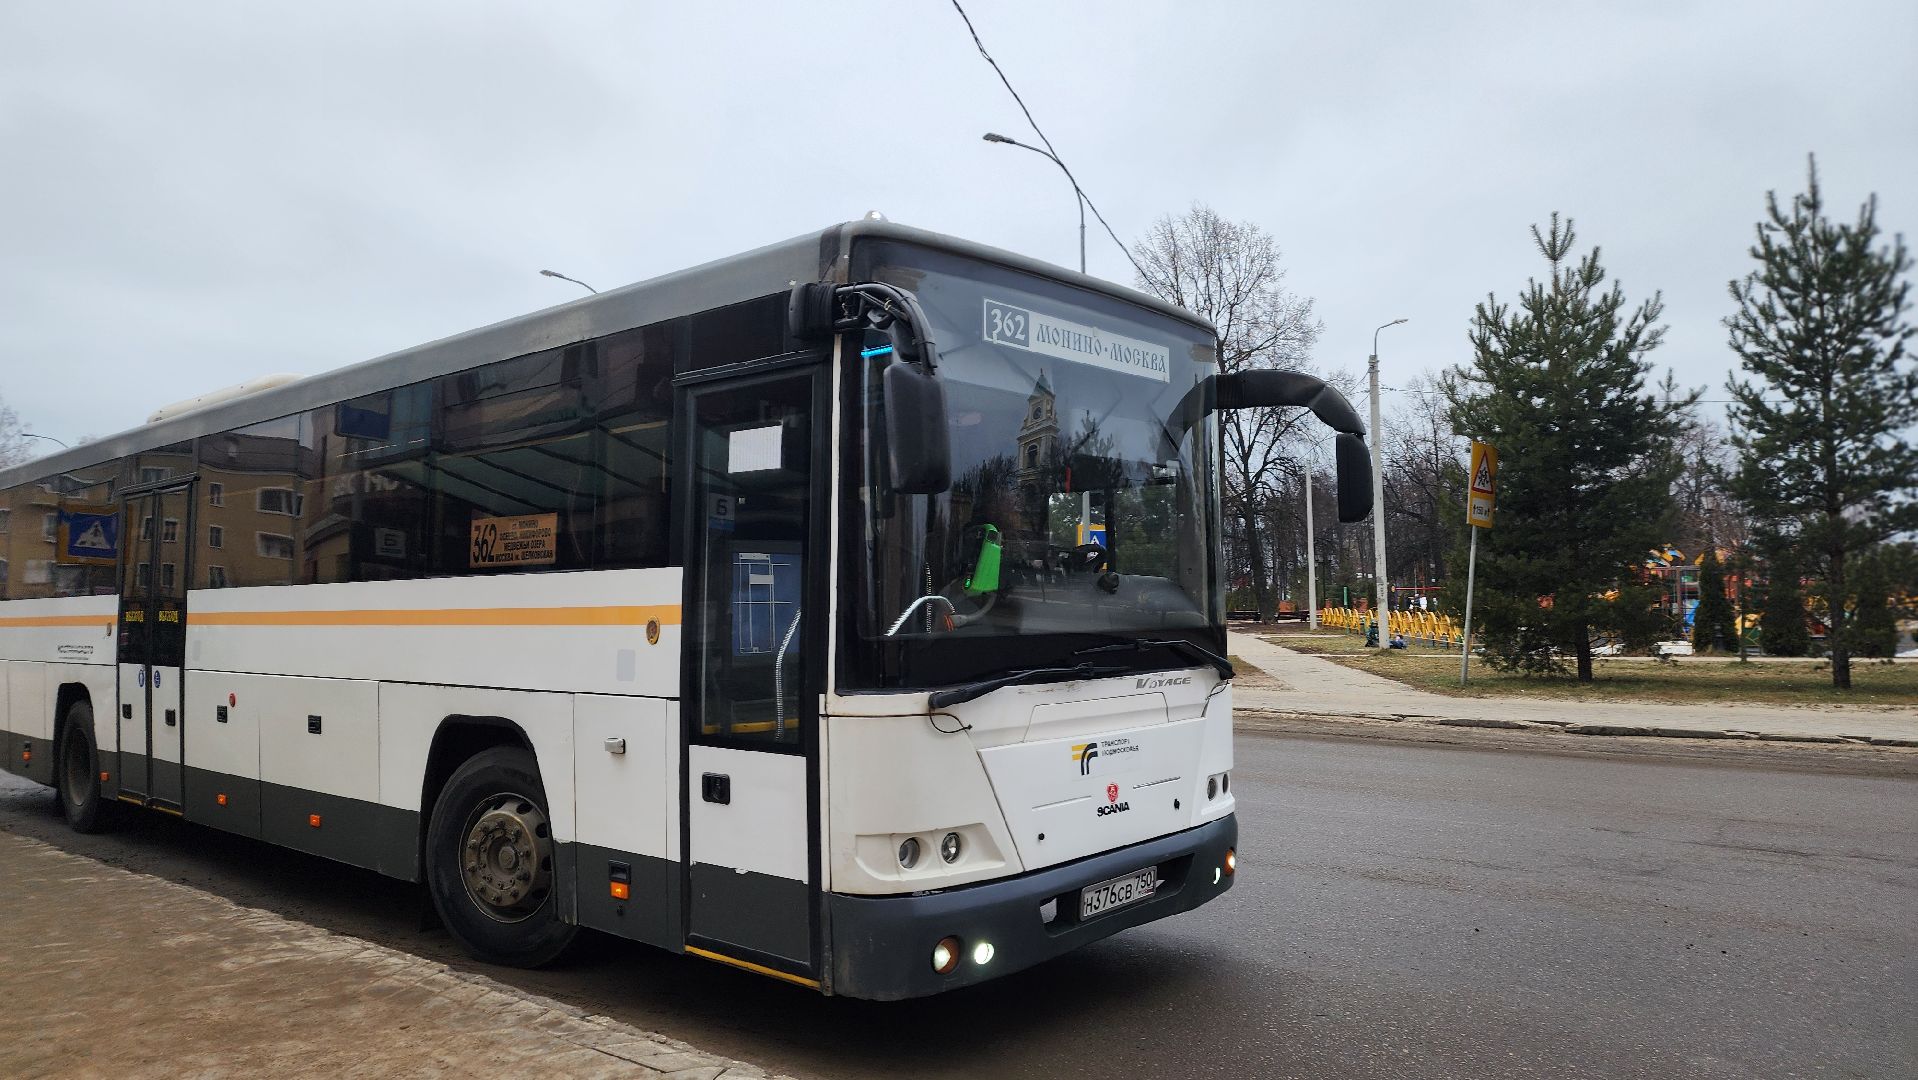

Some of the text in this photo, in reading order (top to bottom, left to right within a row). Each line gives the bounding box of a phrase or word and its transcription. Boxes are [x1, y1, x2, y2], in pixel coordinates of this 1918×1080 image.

[991, 308, 1026, 341] 362
[473, 523, 497, 563] 362
[1097, 802, 1130, 817] SCANIA
